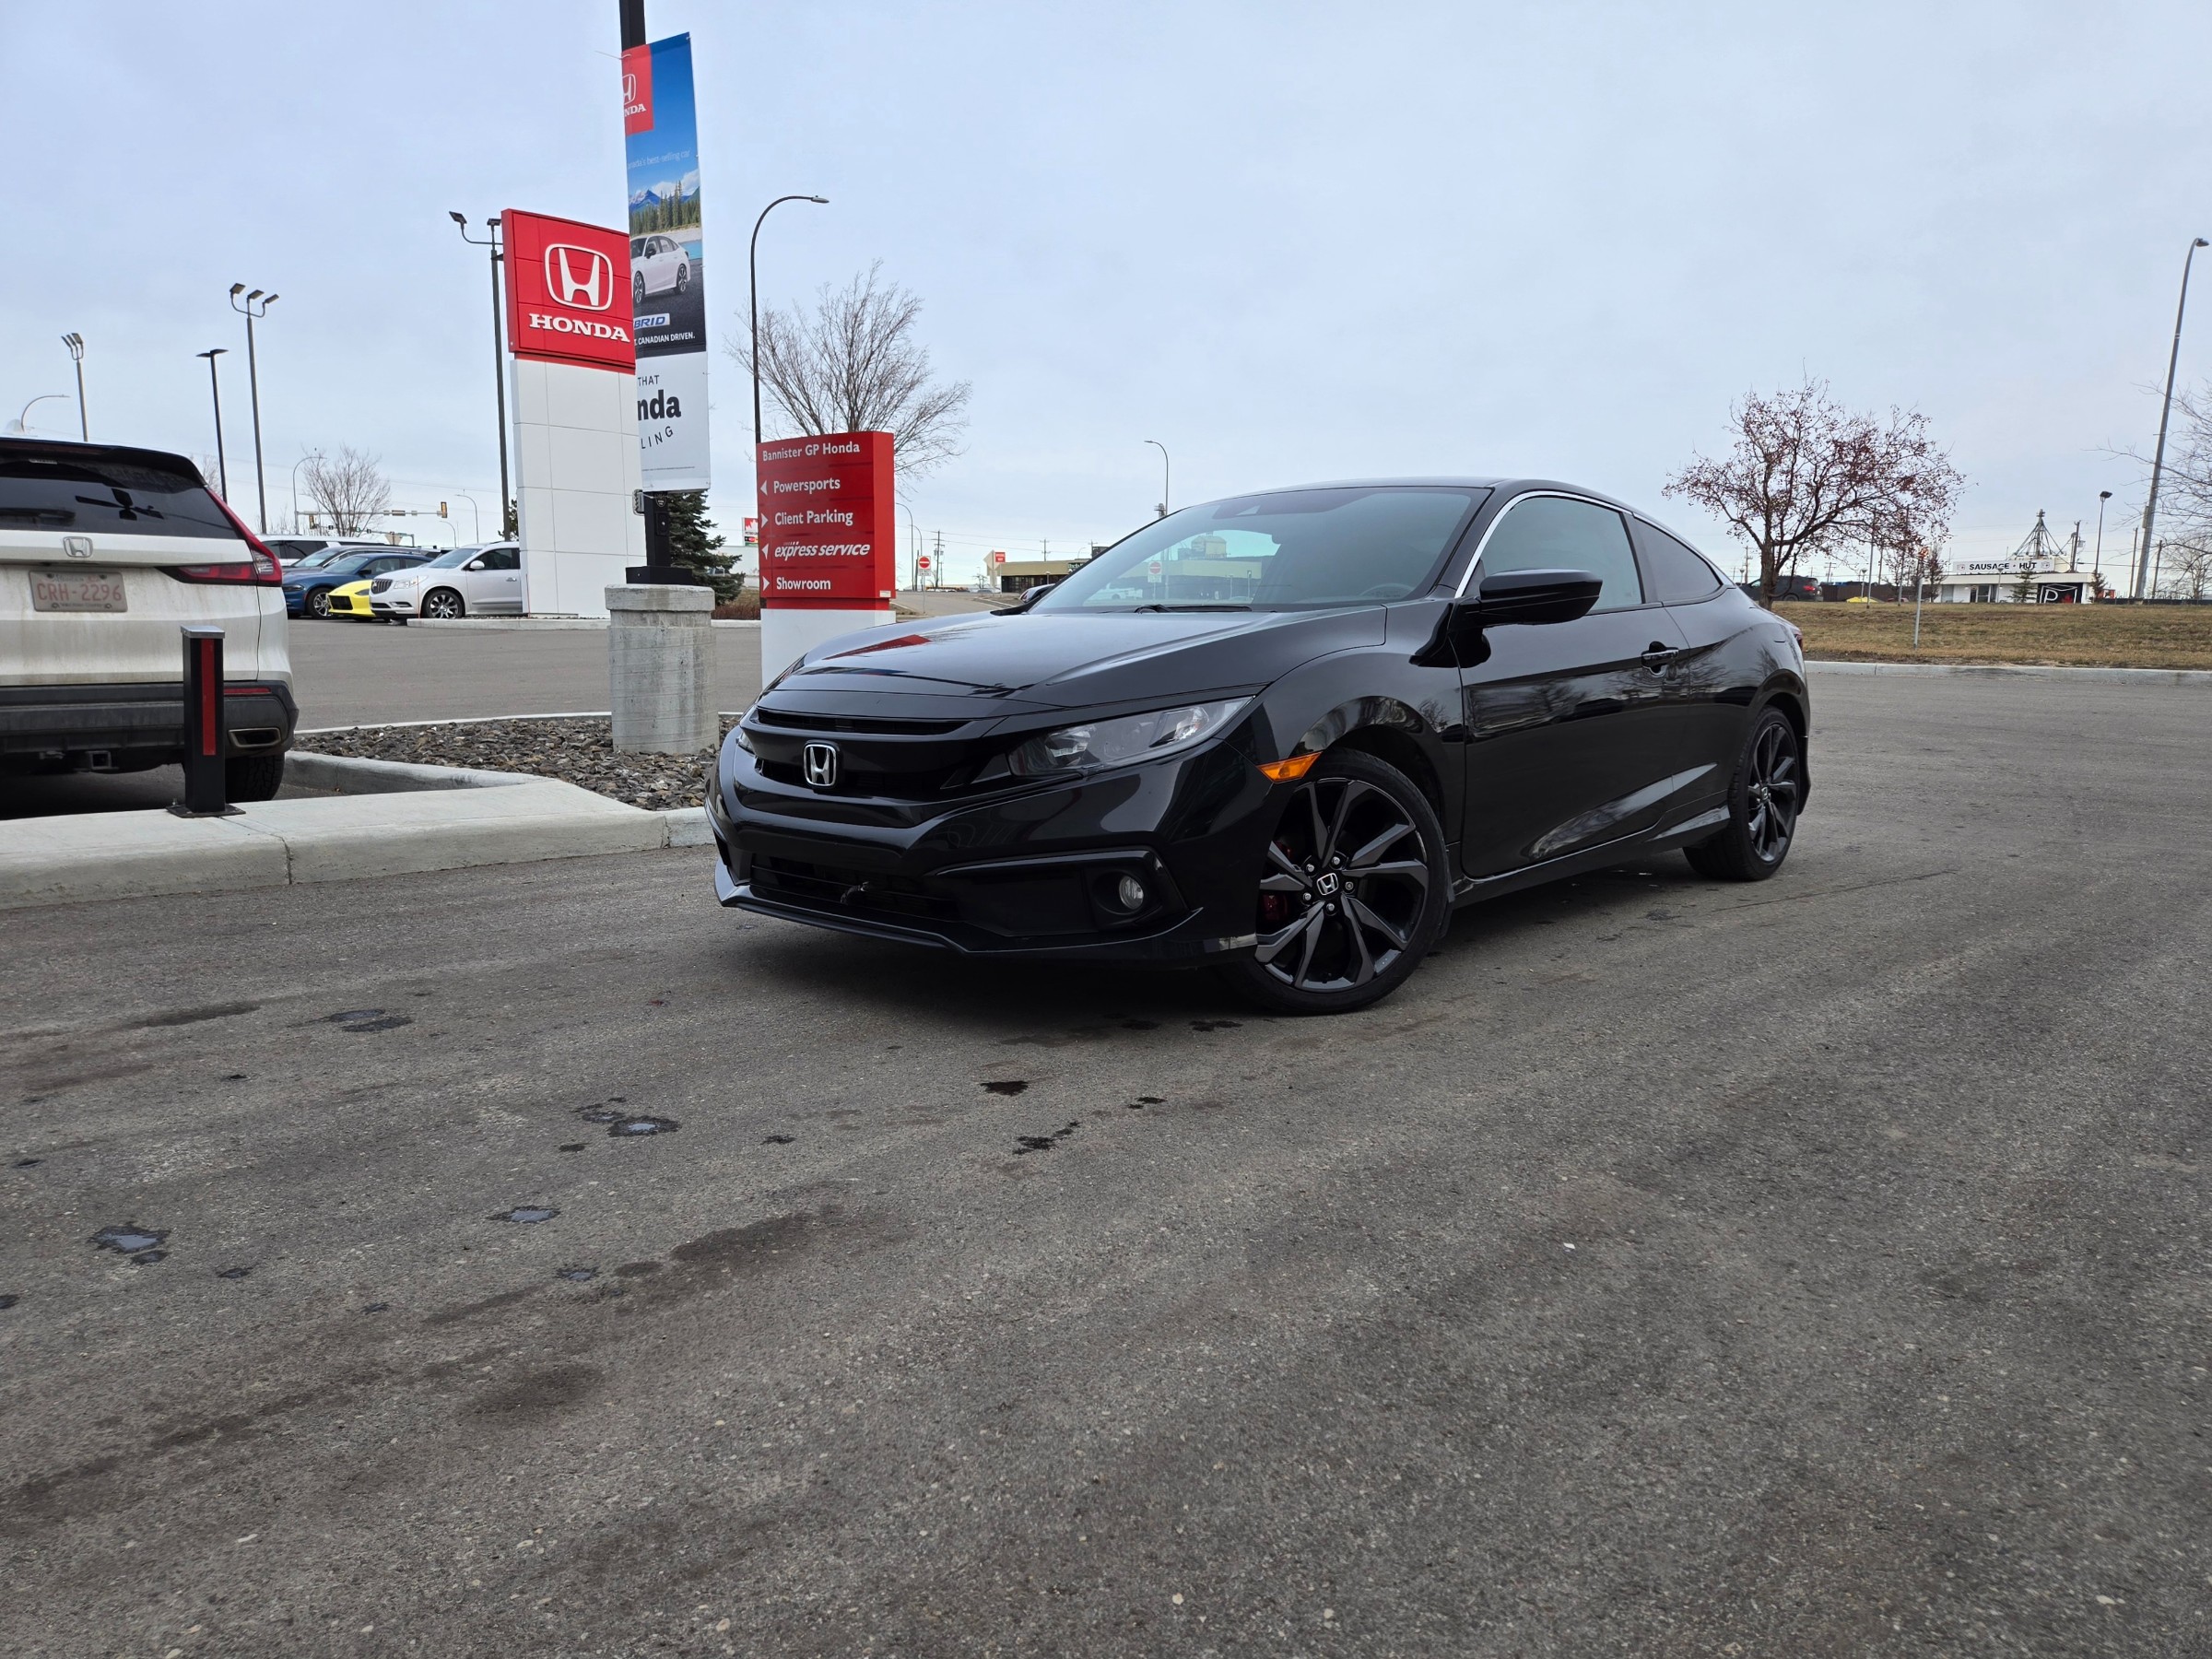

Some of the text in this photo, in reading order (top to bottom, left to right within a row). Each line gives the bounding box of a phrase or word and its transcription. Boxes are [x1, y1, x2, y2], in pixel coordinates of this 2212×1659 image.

[529, 312, 630, 343] HONDA
[638, 334, 669, 345] CANADIAN
[670, 331, 696, 342] DRIVEN.
[637, 374, 660, 387] THAT
[637, 389, 682, 421] nda
[641, 425, 674, 450] LING
[762, 441, 861, 462] Bannister GP Honda
[773, 477, 841, 494] Powersports
[774, 509, 853, 526] Client Parking
[774, 544, 871, 561] express service
[2018, 561, 2038, 571] HUT
[776, 576, 831, 591] Showroom
